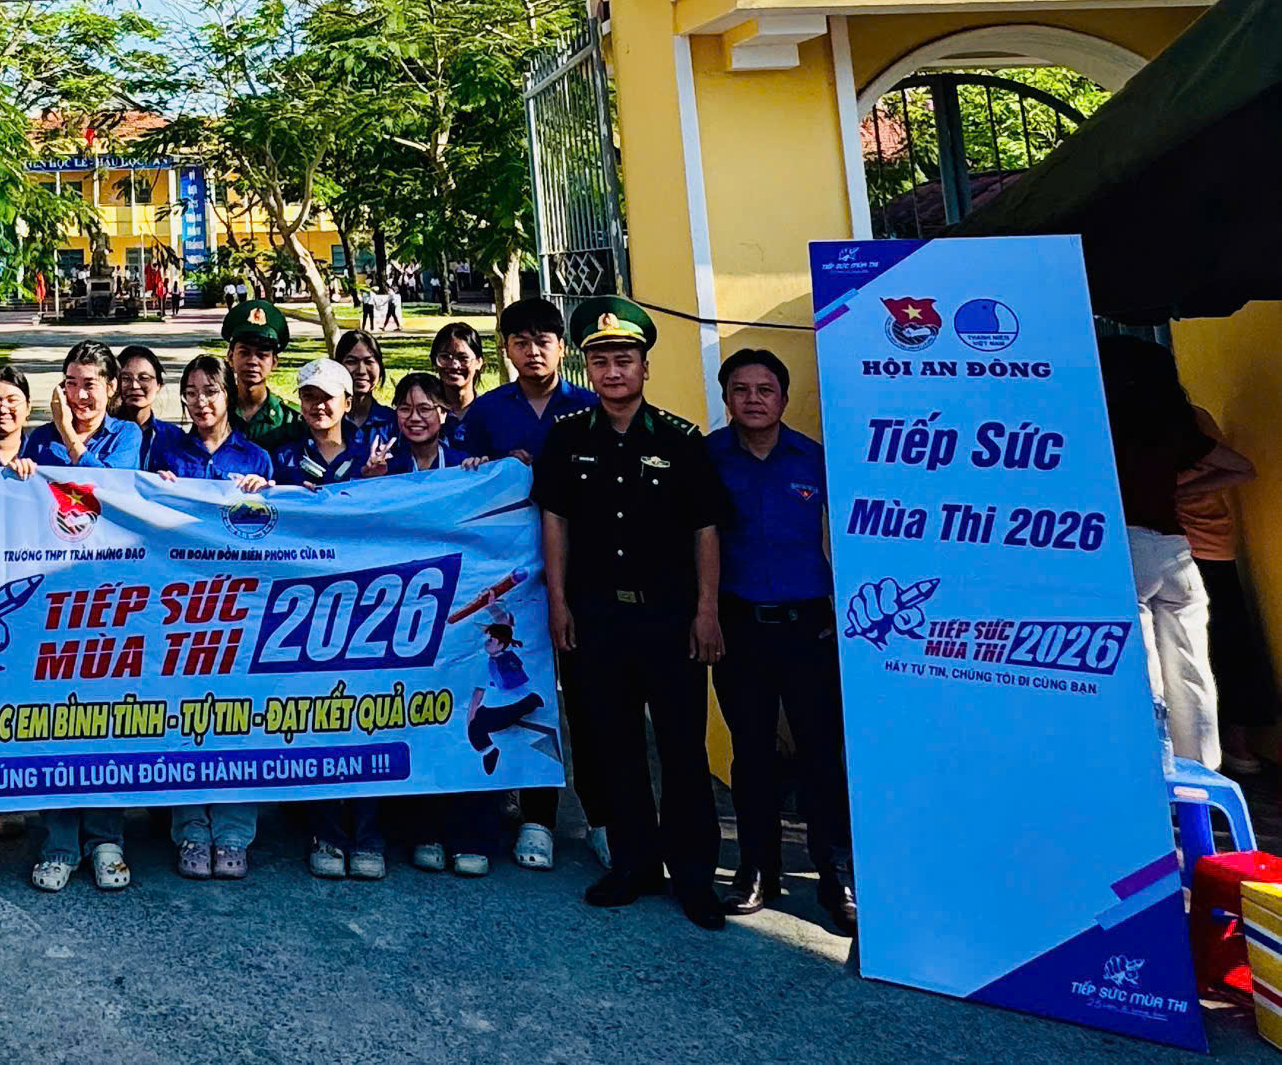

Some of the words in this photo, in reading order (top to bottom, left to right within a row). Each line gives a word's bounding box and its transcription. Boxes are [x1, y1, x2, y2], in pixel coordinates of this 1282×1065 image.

[862, 357, 912, 379] HỘI
[920, 361, 957, 377] AN
[966, 358, 1052, 379] ĐÔNG
[867, 411, 958, 471] Tiếp
[971, 422, 1064, 471] Sức
[846, 498, 928, 540] Mùa
[940, 502, 997, 544] Thi
[1003, 508, 1106, 552] 2026
[45, 549, 67, 561] THPT
[169, 548, 186, 560] CHI
[45, 581, 150, 630] TIẾP
[160, 574, 259, 625] SỨC
[259, 567, 445, 663] 2026
[928, 618, 971, 639] TIẾP
[974, 618, 1015, 641] SỨC
[34, 632, 145, 680] MÙA
[161, 628, 244, 676] THI
[925, 638, 968, 660] MÙA
[973, 642, 1007, 663] THI
[1011, 624, 1124, 670] 2026
[911, 663, 926, 676] TỰ
[928, 665, 948, 679] TIN,
[951, 667, 992, 682] CHÚNG
[995, 672, 1015, 685] TÔI
[1032, 675, 1067, 691] CÙNG
[1070, 681, 1097, 695] BẠN
[15, 704, 50, 741] EM
[51, 693, 110, 740] BÌNH
[111, 693, 167, 737] TĨNH
[181, 692, 214, 746] TỰ
[214, 698, 252, 735] TIN
[265, 696, 313, 743] ĐẠT
[312, 680, 356, 732] KẾT
[356, 682, 406, 735] QUẢ
[408, 688, 453, 726] CAO
[42, 761, 74, 786] TÔI
[80, 759, 133, 786] LUÔN
[138, 756, 195, 784] ĐỒNG
[200, 757, 257, 783] HÀNH
[262, 754, 318, 779] CÙNG
[323, 755, 363, 780] BẠN
[371, 753, 390, 774] !!!
[1071, 979, 1096, 996] TIẾP
[1098, 986, 1127, 1002] SỨC
[1167, 997, 1188, 1013] THI
